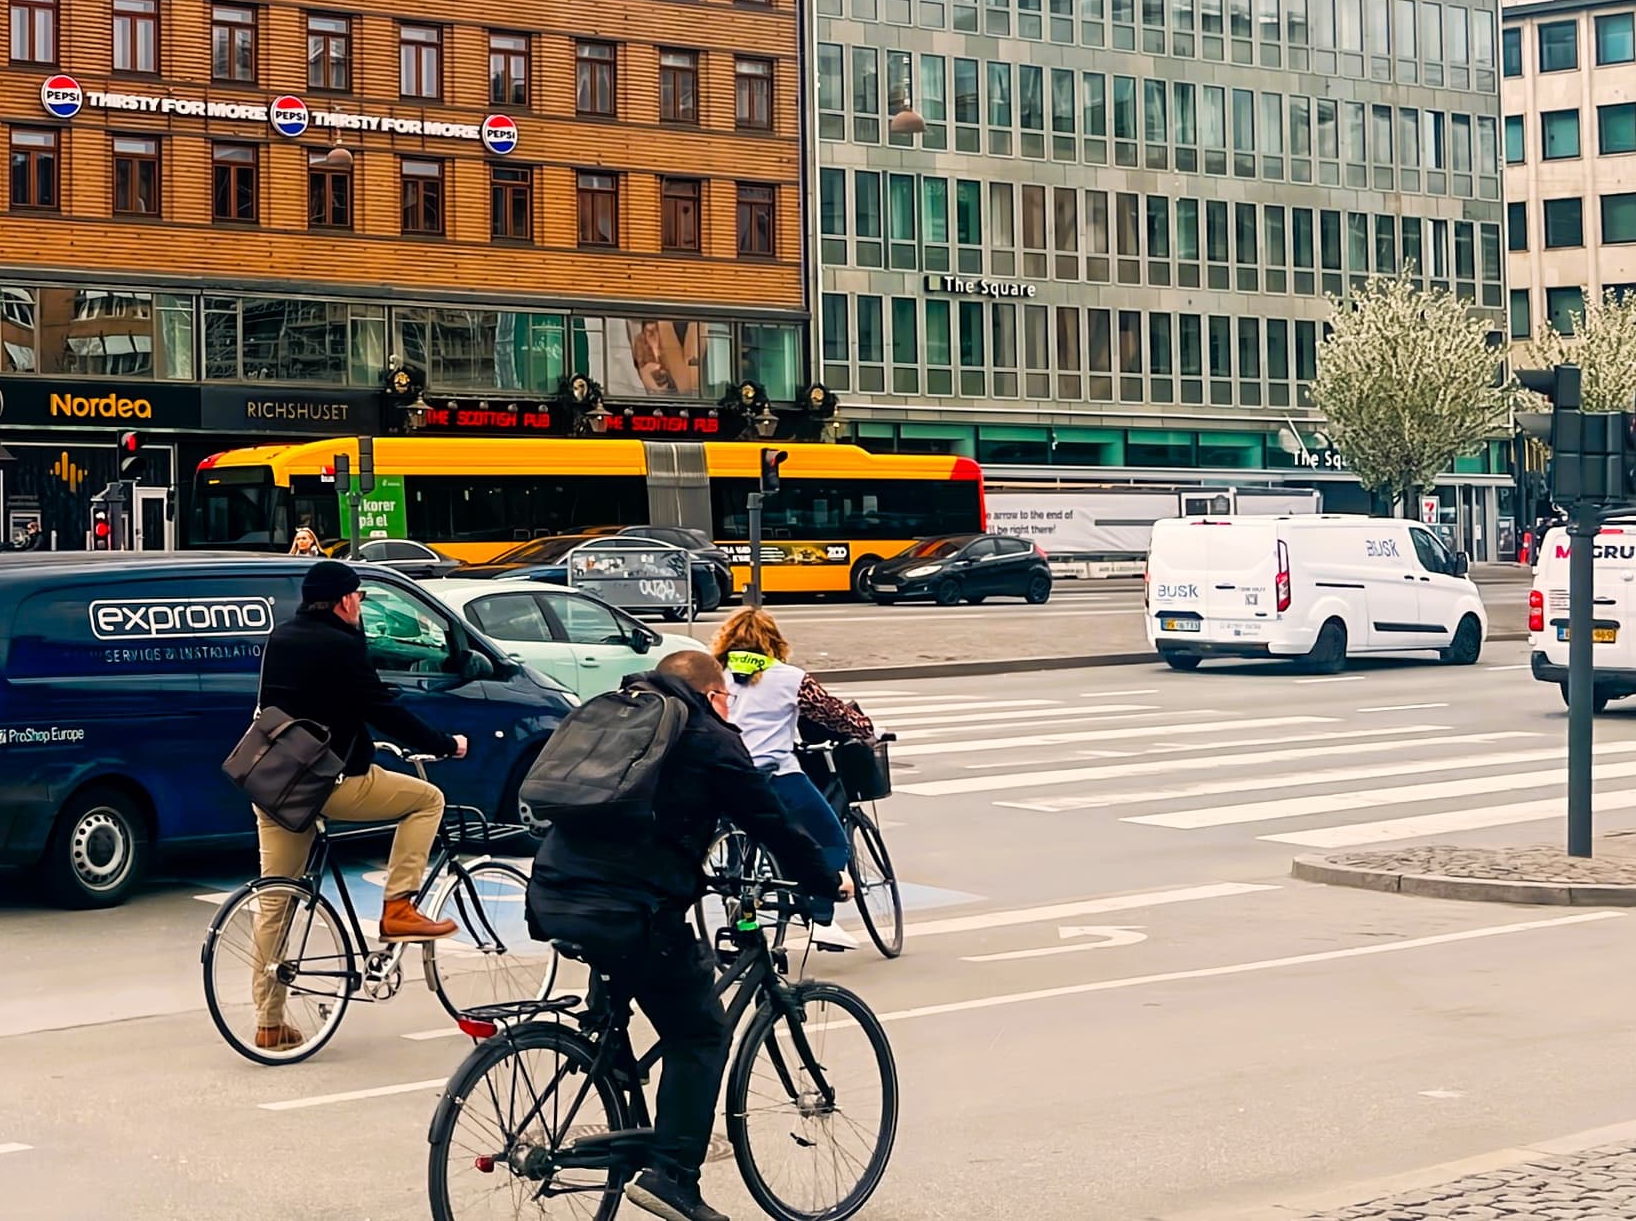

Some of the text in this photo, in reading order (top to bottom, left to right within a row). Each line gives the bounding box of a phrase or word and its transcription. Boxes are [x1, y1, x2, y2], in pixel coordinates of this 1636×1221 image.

[46, 90, 79, 102] PEPSI
[86, 91, 269, 121] THIRSTY FOR MORE
[275, 110, 306, 122] PEPSI
[311, 111, 481, 139] THIRSTY FOR MORE
[487, 128, 516, 140] PEPSI
[944, 276, 1037, 299] The Square
[49, 393, 152, 419] Nordea
[247, 401, 349, 420] RICHSHUSET
[426, 409, 550, 428] THE SCOTTISH PUB
[1294, 450, 1319, 467] The
[1030, 510, 1044, 519] the
[1046, 510, 1063, 519] end
[97, 603, 267, 635] expromo
[105, 648, 162, 662] SERVICE
[9, 726, 85, 744] ProShop Europe
